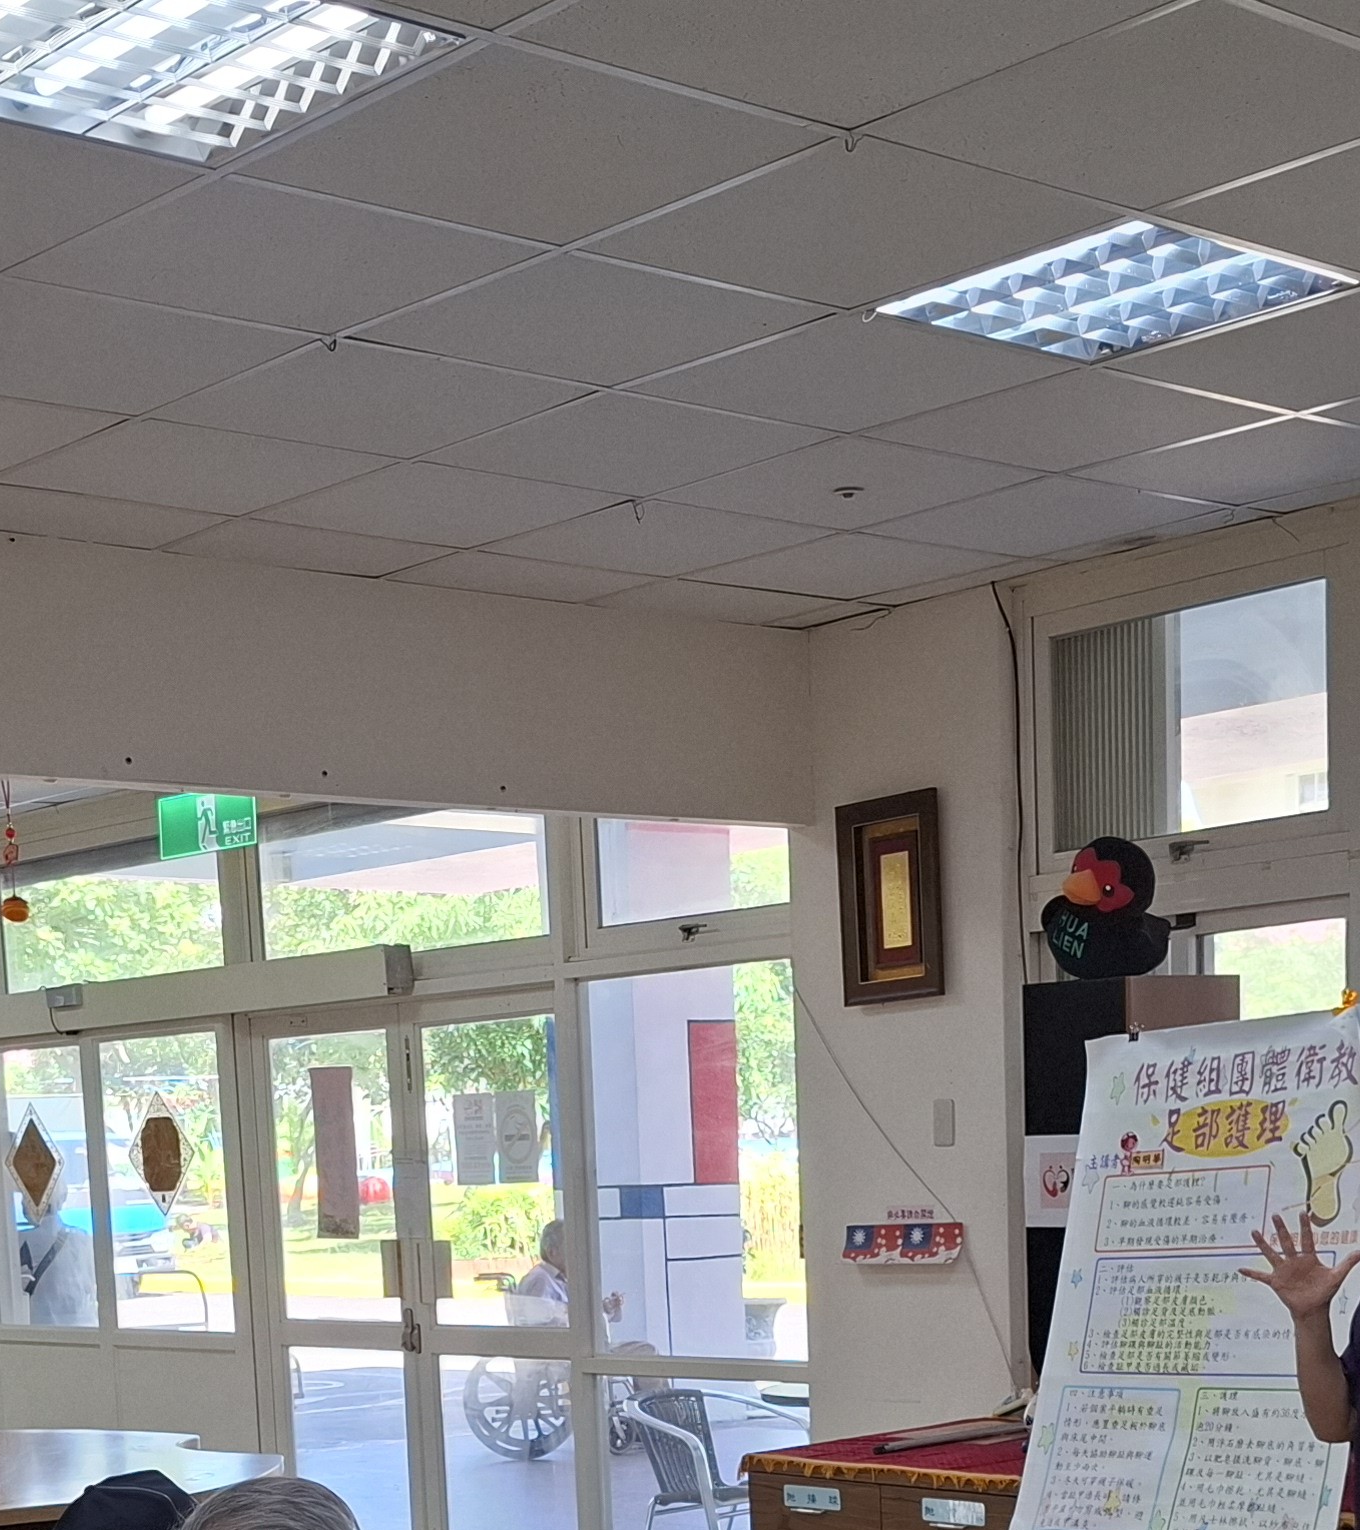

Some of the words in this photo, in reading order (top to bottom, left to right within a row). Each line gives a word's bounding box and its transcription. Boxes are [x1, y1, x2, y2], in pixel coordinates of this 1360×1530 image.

[225, 833, 251, 845] EXIT
[1052, 929, 1085, 959] LIEN
[1133, 1039, 1360, 1106] 保健組團體衛教
[1159, 1099, 1288, 1152] 足部護理
